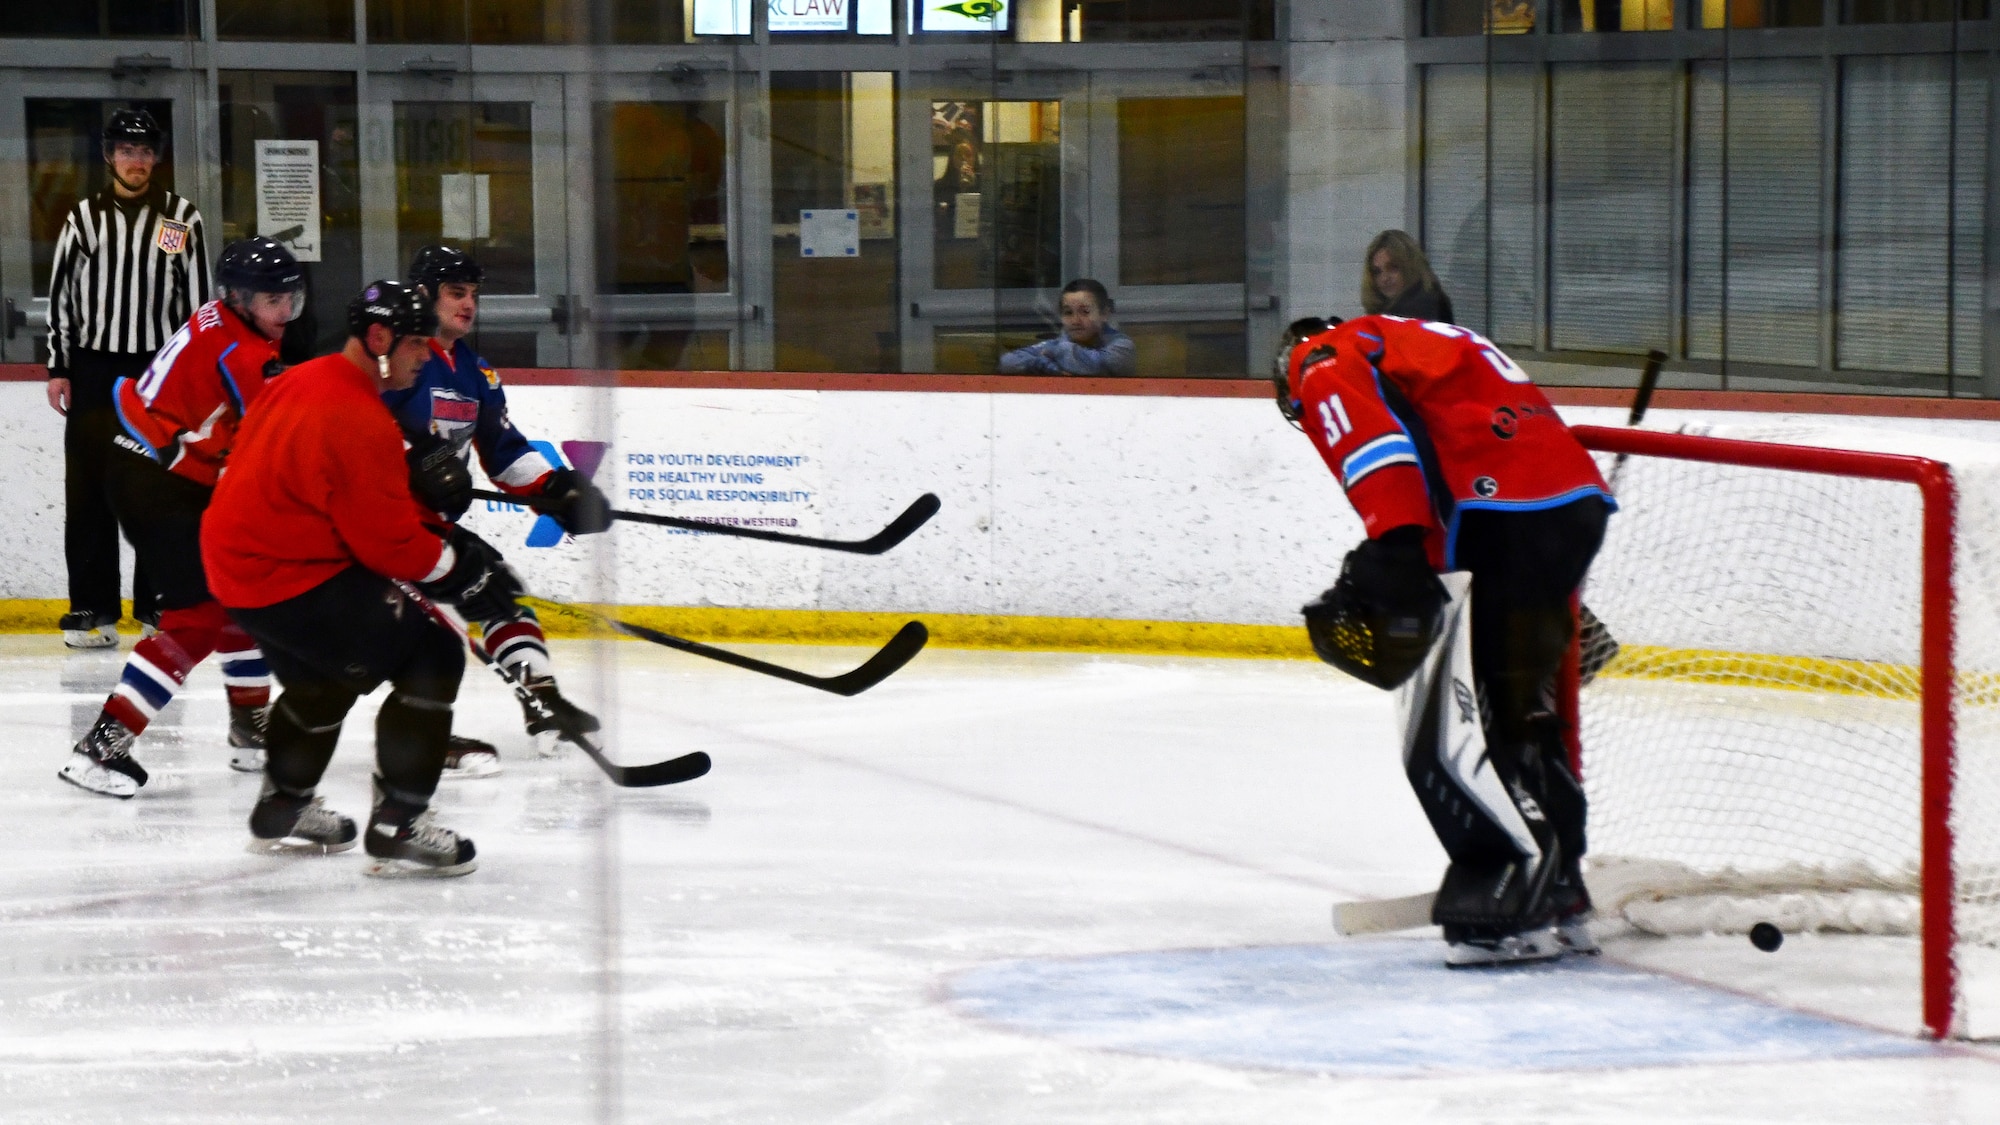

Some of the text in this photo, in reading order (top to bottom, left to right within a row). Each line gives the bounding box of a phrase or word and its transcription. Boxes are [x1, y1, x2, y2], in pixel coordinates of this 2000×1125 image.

[1318, 393, 1353, 447] 31
[628, 453, 801, 467] FOR YOUTH DEVELOPMENT
[628, 471, 763, 485] FOR HEALTHY LIVING
[629, 488, 810, 502] FOR SOCIAL RESPONSIBILITY
[742, 517, 798, 527] WESTFIELD
